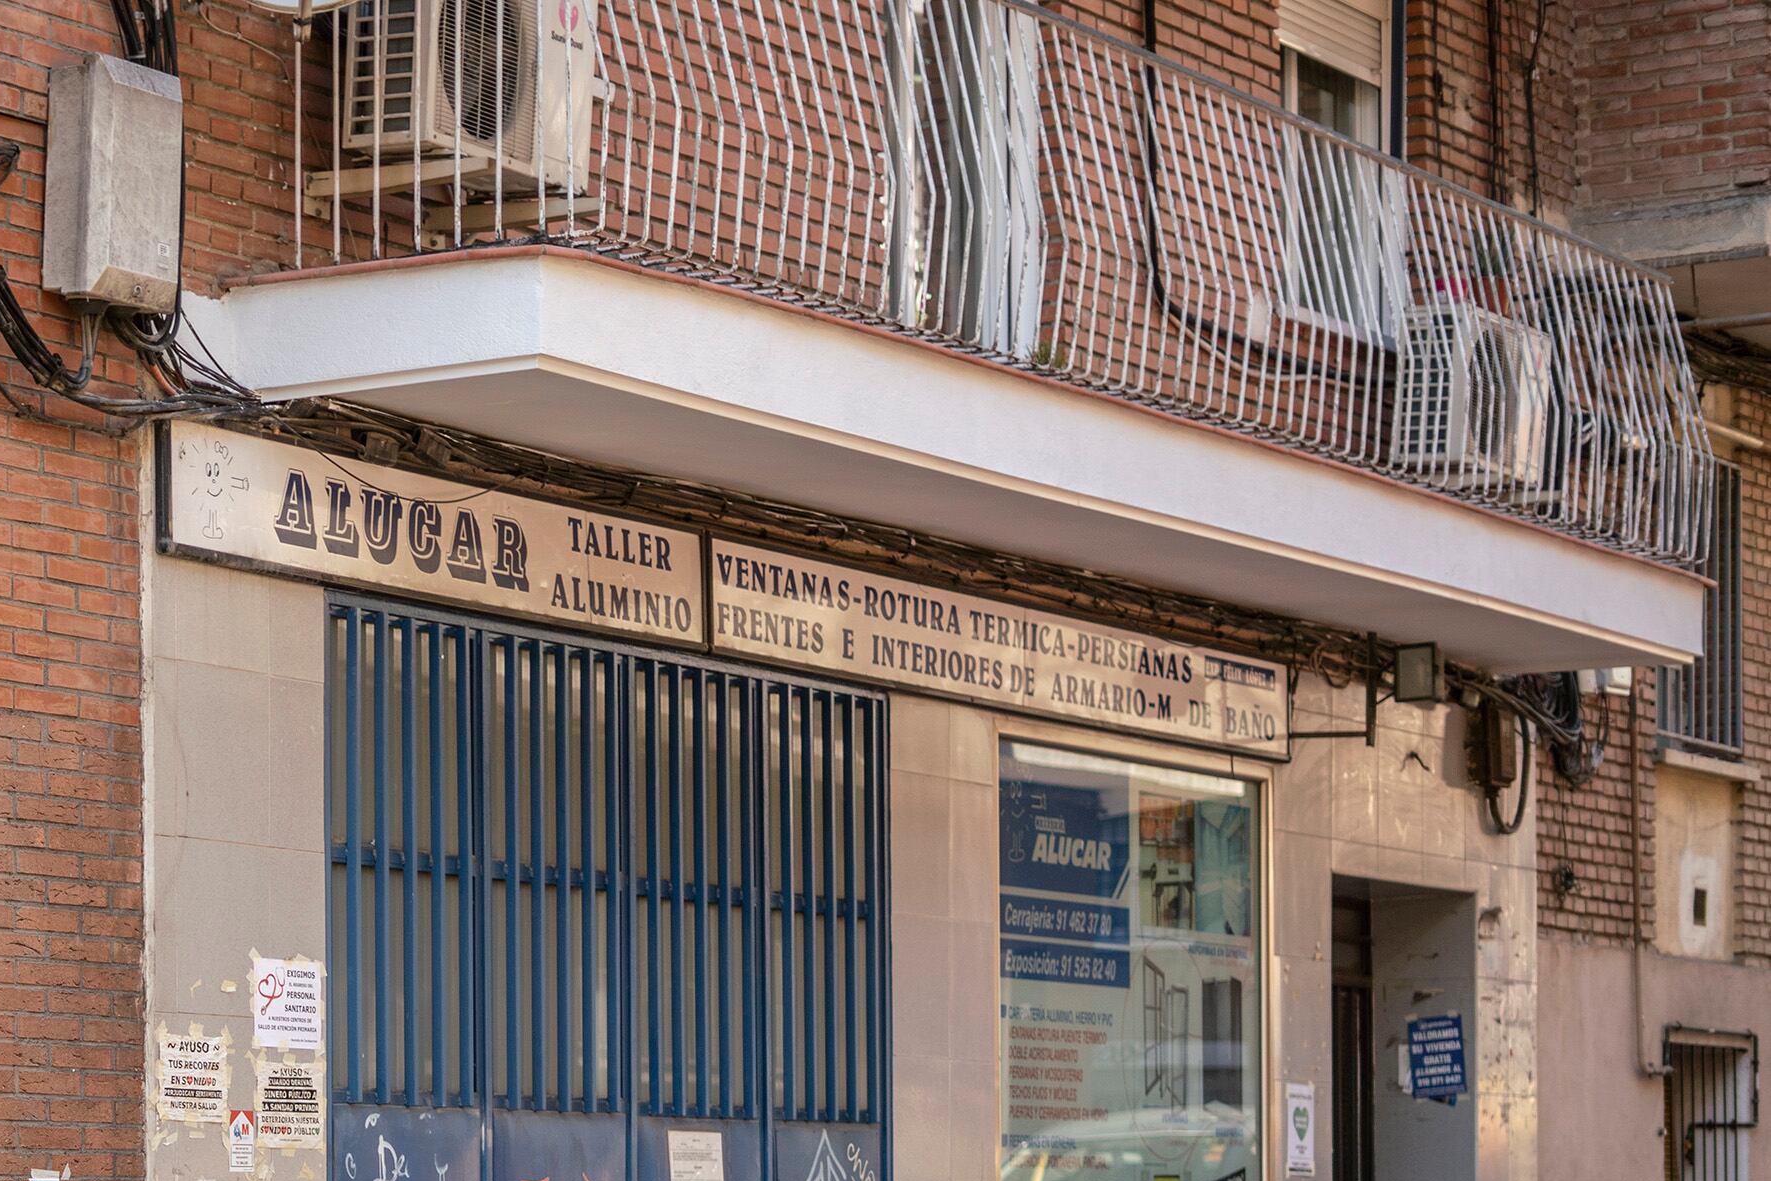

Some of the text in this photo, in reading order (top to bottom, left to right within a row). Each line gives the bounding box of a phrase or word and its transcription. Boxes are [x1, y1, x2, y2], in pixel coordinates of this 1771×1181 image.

[274, 468, 531, 593] ALUCAR
[568, 516, 672, 572] TALLER
[551, 573, 692, 633] ALUMINIO
[717, 602, 824, 654] FRENTES
[842, 629, 855, 660] E
[872, 636, 1004, 690] INTERIORES
[1009, 663, 1036, 697] DE
[1189, 697, 1213, 731] DE
[1225, 702, 1276, 742] BAÑO
[1032, 833, 1112, 871] ALUCAR
[1056, 909, 1067, 930] 91
[1088, 911, 1100, 934] 37
[1004, 949, 1060, 978] Exposición:
[1060, 954, 1072, 977] 91
[1074, 956, 1091, 978] 525
[1104, 959, 1117, 981] 40
[286, 969, 316, 979] EXIGIMOS
[286, 990, 316, 1001] PERSONAL
[284, 1004, 317, 1014] SANITARIO
[179, 1041, 209, 1053] AYUSO
[1424, 1040, 1462, 1054] VIVIENDA
[168, 1059, 220, 1071] TUS RECORTES
[280, 1068, 303, 1077] AYUSO
[171, 1075, 181, 1085] EN
[264, 1090, 287, 1099] DINERO
[170, 1101, 218, 1110] NUESTRA SALUD
[262, 1103, 270, 1111] LA
[294, 1104, 319, 1112] PRIVADA
[261, 1115, 295, 1124] DETERIORAS
